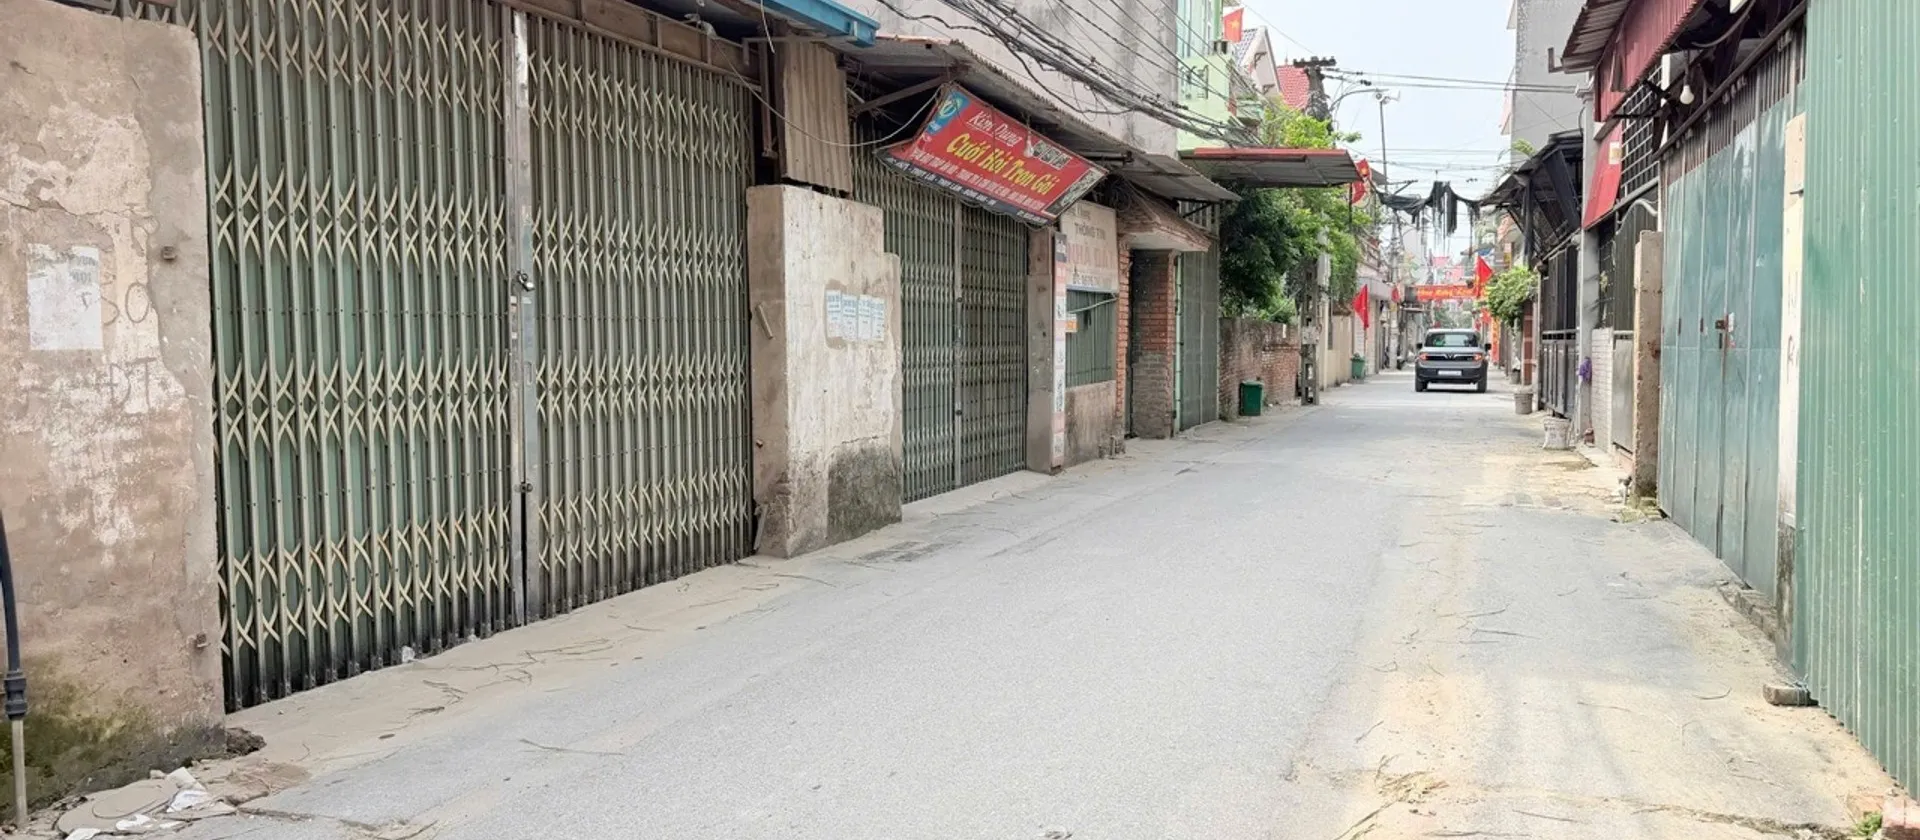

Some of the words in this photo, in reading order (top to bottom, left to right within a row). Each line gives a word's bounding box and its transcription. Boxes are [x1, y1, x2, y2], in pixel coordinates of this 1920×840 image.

[968, 110, 993, 132] Kim
[994, 123, 1022, 147] Dung
[946, 133, 991, 163] Cưới
